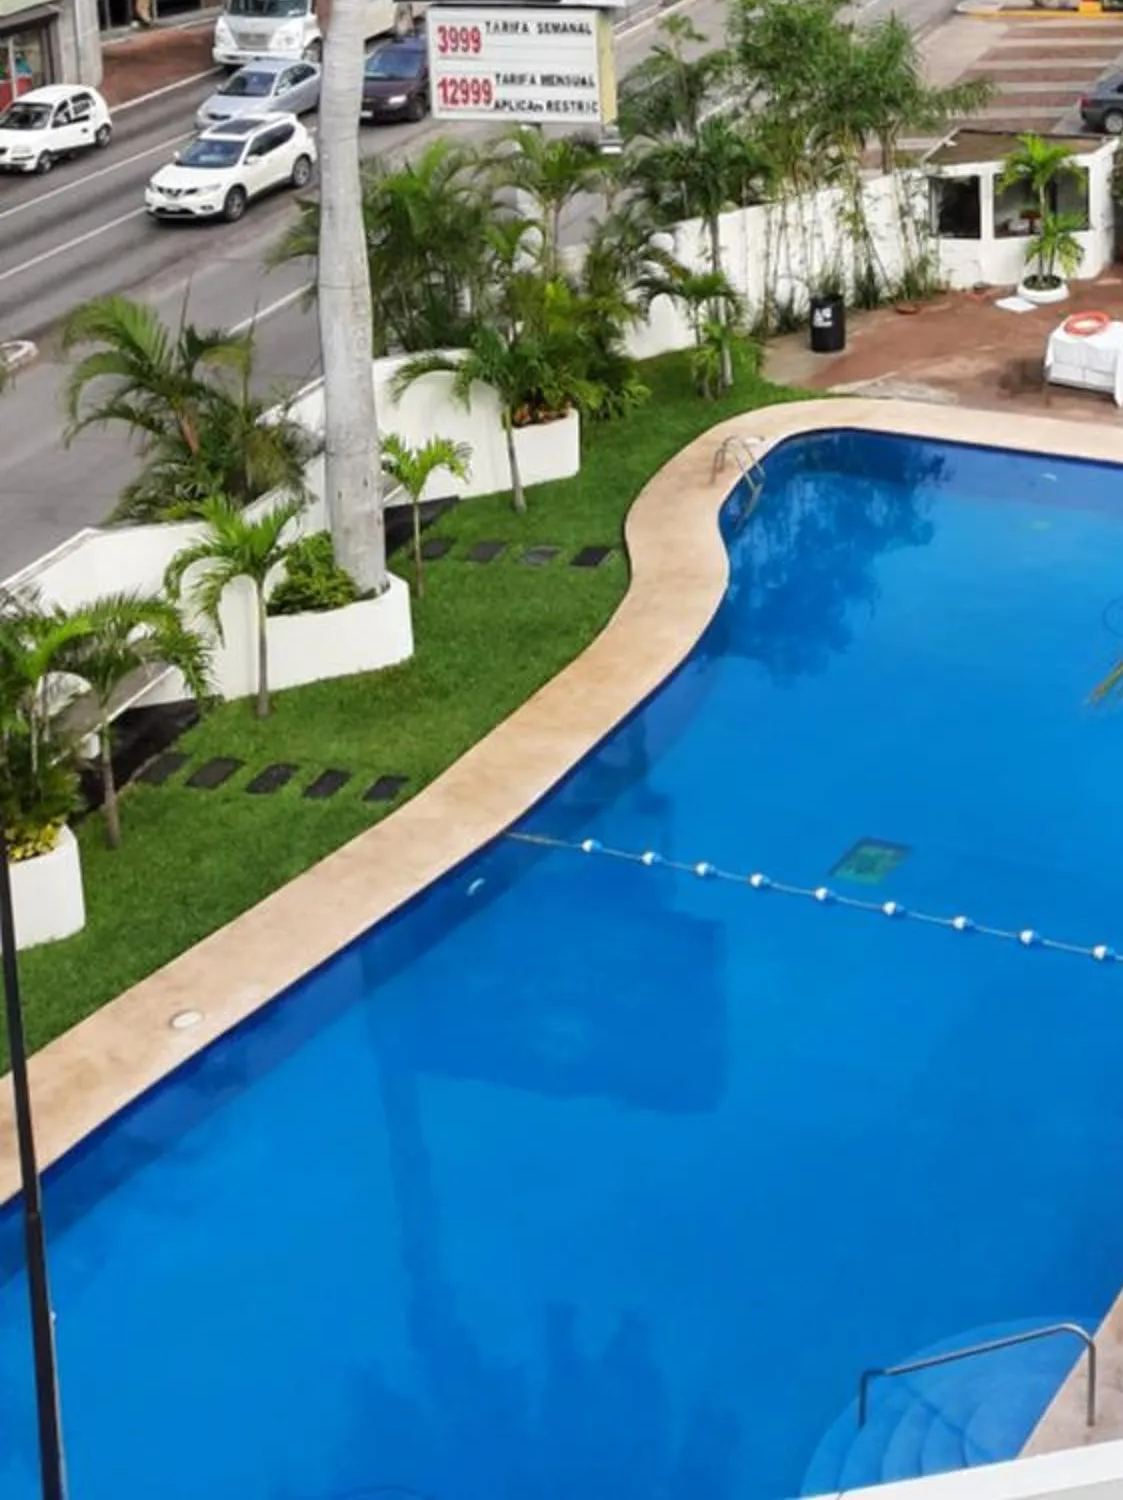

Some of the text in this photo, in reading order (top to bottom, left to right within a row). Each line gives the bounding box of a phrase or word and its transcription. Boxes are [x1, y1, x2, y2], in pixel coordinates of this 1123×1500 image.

[437, 20, 592, 53] 3999 TARIFA SEMANAL
[437, 73, 595, 105] 12999 TARIFA MENSUAL
